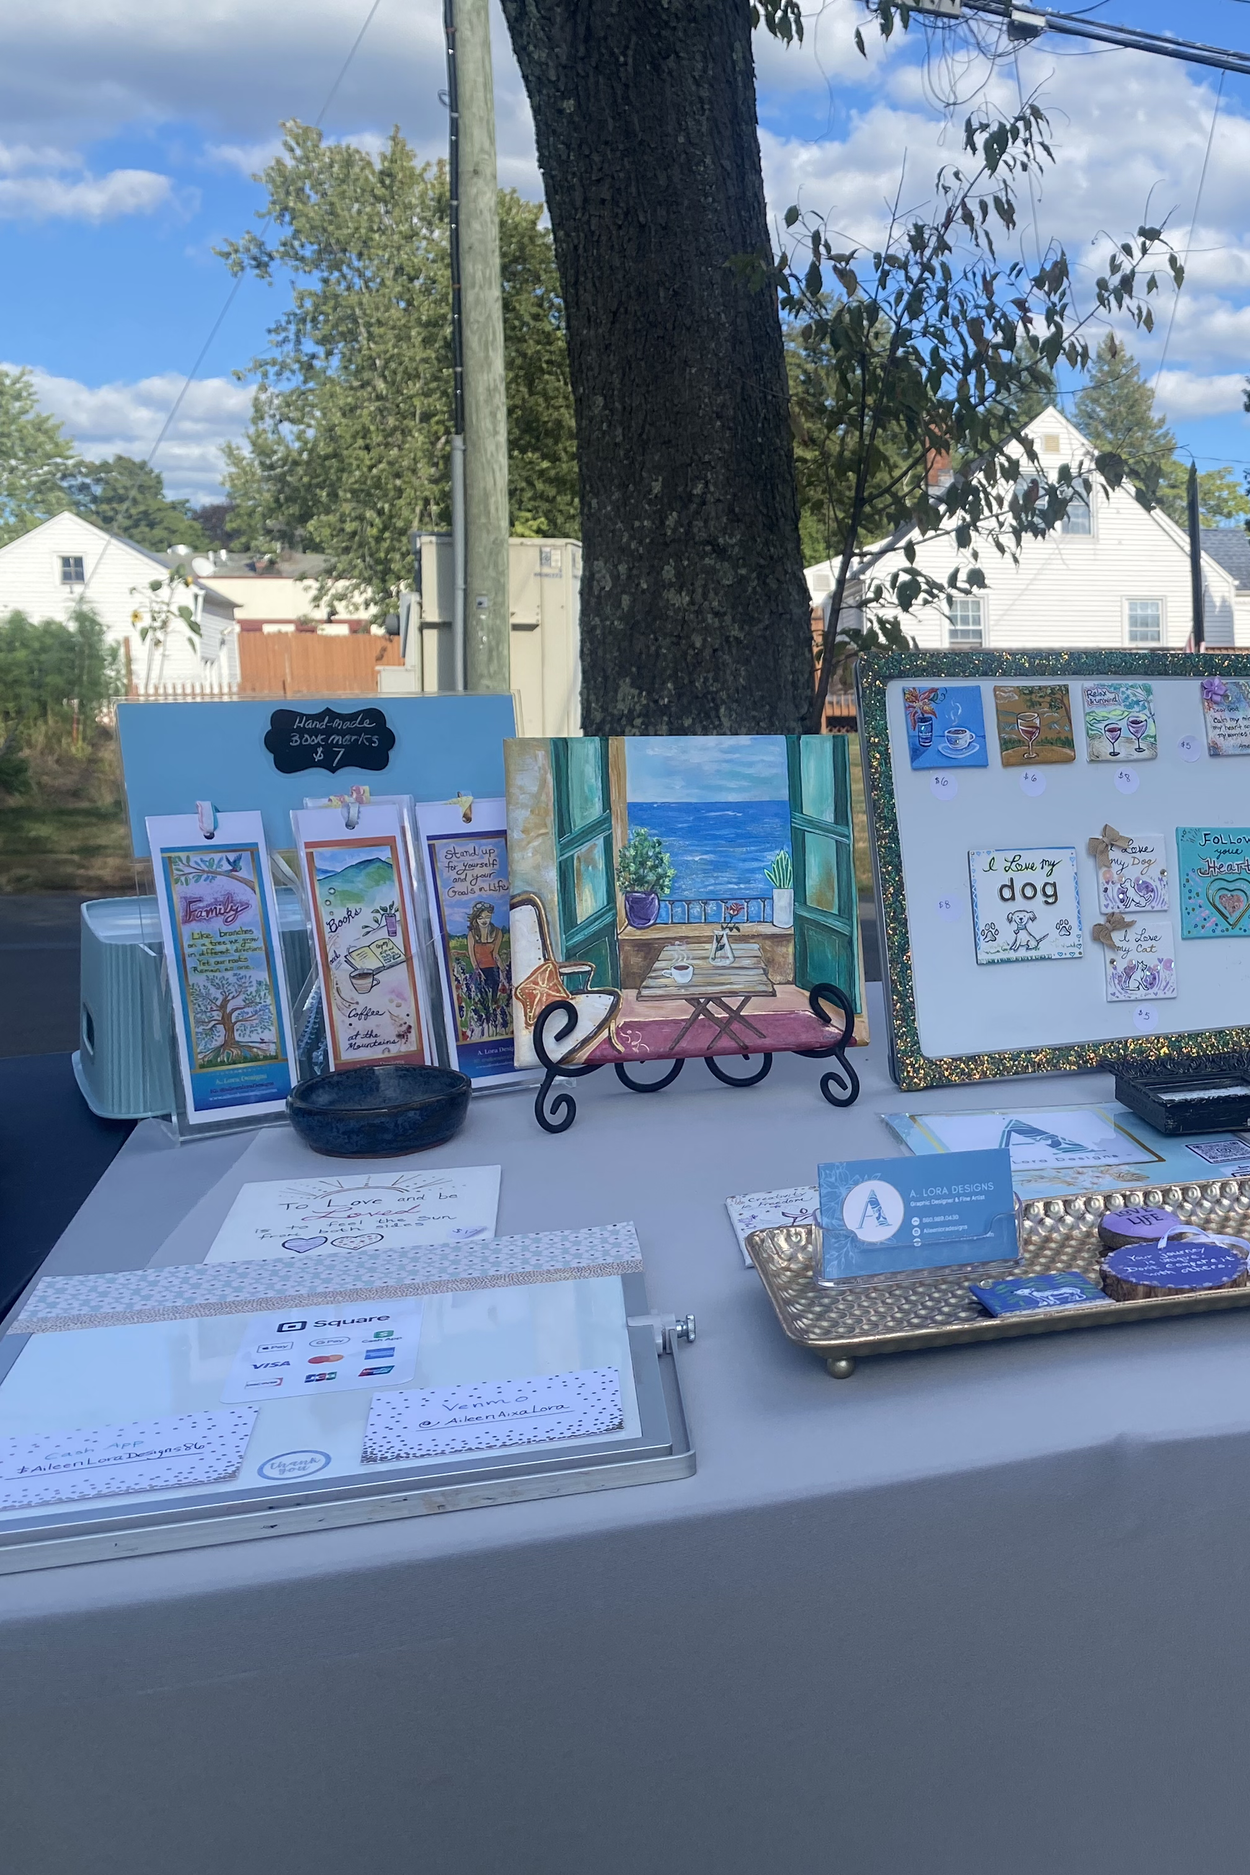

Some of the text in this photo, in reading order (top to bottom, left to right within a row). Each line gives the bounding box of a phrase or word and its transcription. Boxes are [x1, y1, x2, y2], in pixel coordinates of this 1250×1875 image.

[481, 848, 496, 858] up
[444, 858, 498, 876] for yourself
[1003, 854, 1038, 873] Love
[1039, 858, 1063, 878] my
[1131, 856, 1158, 876] Dog
[452, 871, 497, 887] and your
[447, 886, 476, 898] Goals
[997, 877, 1059, 906] dog
[185, 893, 250, 925] Family
[326, 907, 363, 934] Books
[191, 930, 213, 940] Like
[1134, 927, 1162, 942] Love
[1135, 943, 1158, 953] Cat
[347, 1006, 386, 1021] Coffee
[347, 1029, 381, 1042] at the
[345, 1038, 400, 1053] Mountains
[1054, 1154, 1120, 1163] Designs
[922, 1186, 949, 1197] LORA
[951, 1181, 995, 1195] DESIGNS
[278, 1192, 458, 1211] To Love and be
[301, 1204, 420, 1222] Loved
[1115, 1206, 1154, 1218] LOVE
[1127, 1212, 1164, 1226] LIFE
[313, 1314, 391, 1328] Square
[252, 1360, 291, 1370] VISA
[442, 1395, 529, 1411] Venmo
[44, 1447, 95, 1461] Cash
